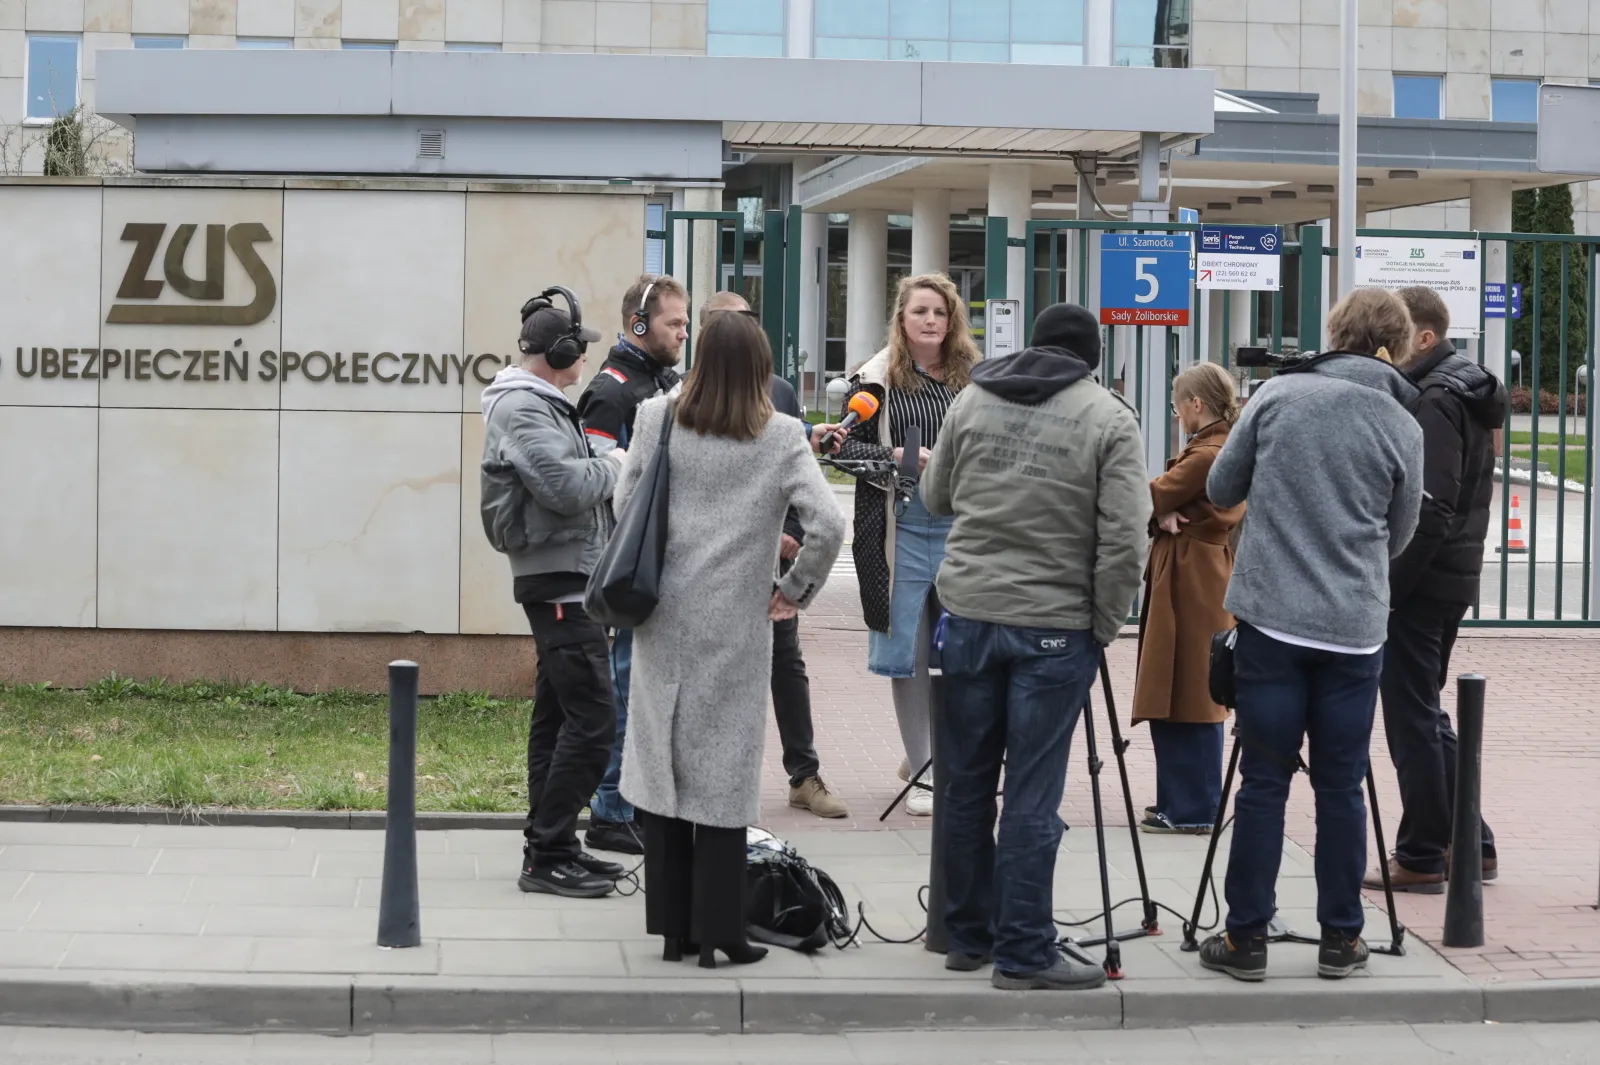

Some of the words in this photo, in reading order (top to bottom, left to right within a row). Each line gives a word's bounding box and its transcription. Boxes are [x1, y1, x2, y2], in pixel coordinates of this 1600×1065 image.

[1119, 237, 1130, 247] Ul.
[1133, 237, 1174, 248] Szamocka
[1204, 235, 1219, 243] seris
[1409, 248, 1425, 259] ZUS
[106, 222, 277, 326] ZUS
[1134, 256, 1159, 304] 5
[1111, 310, 1132, 322] Sady
[1135, 309, 1179, 321] Żoliborskie
[16, 338, 250, 382] UBEZPIECZEŃ
[258, 350, 512, 385] SPOŁECZNYC
